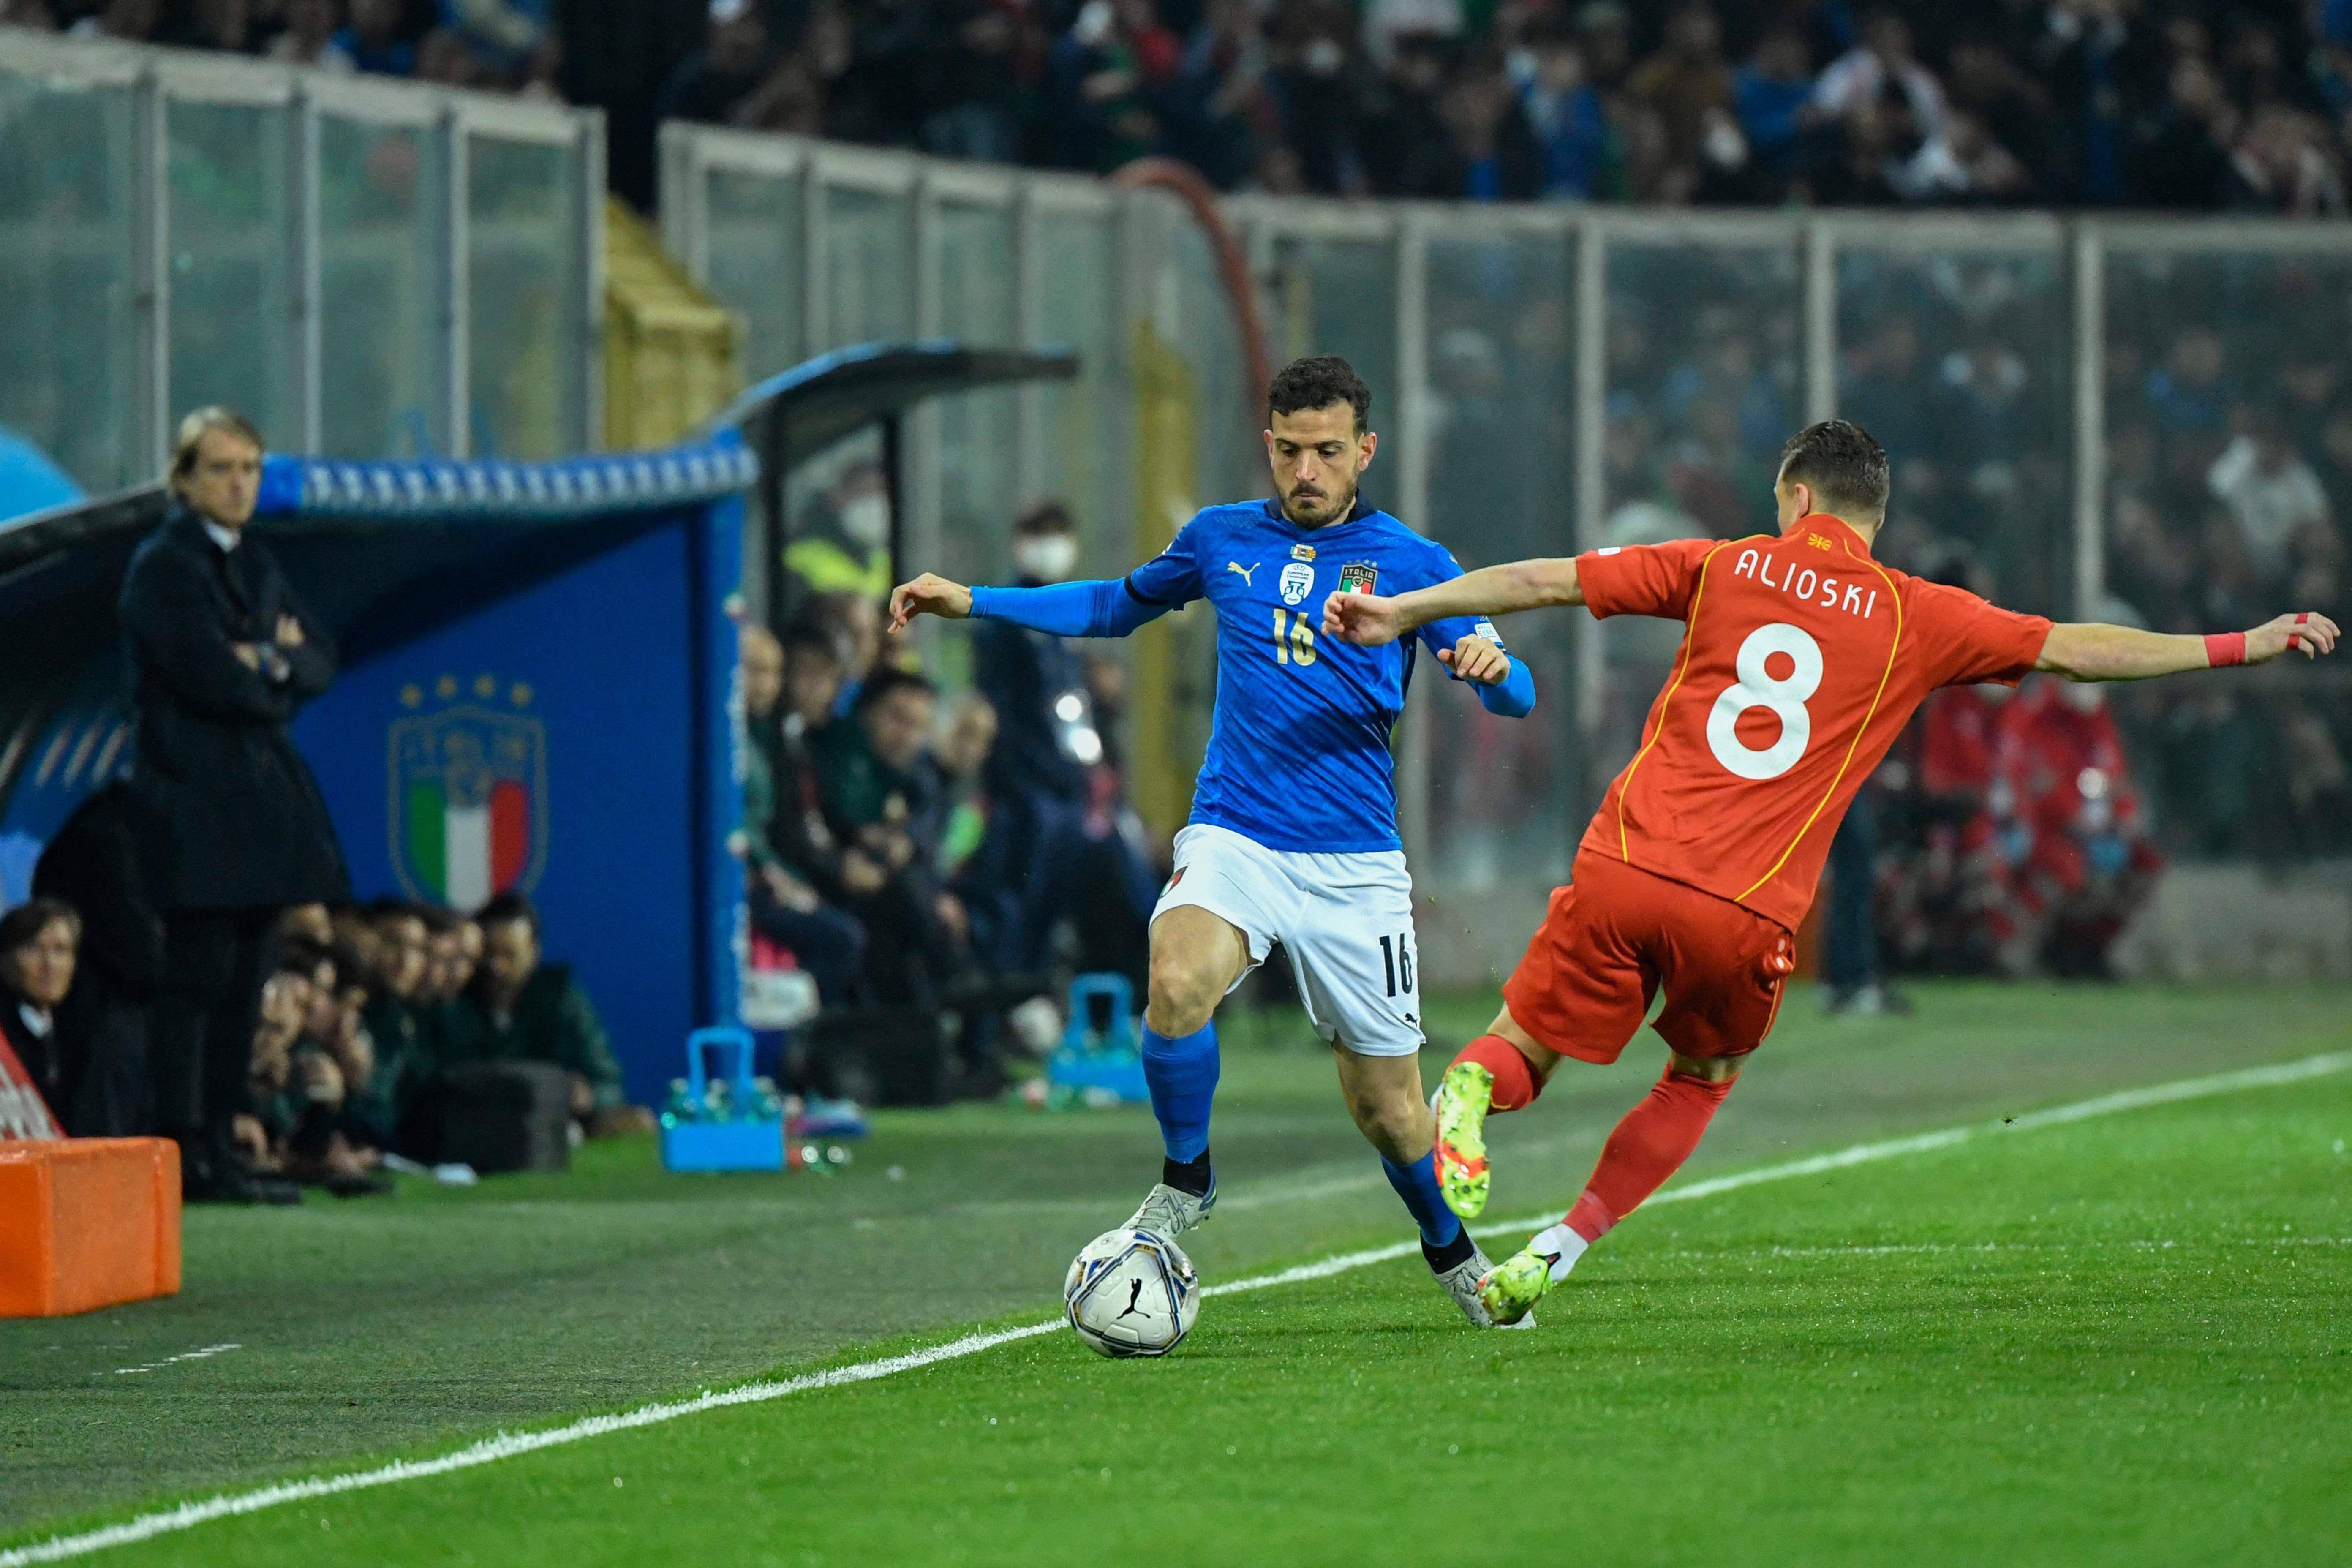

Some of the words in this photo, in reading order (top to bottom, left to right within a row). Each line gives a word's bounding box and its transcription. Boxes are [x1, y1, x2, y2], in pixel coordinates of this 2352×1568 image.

[1345, 569, 1373, 579] ITALIA
[1734, 549, 1876, 618] ALIOSKI
[1273, 608, 1317, 666] 16
[1706, 623, 1824, 780] 8
[1379, 933, 1413, 997] 16
